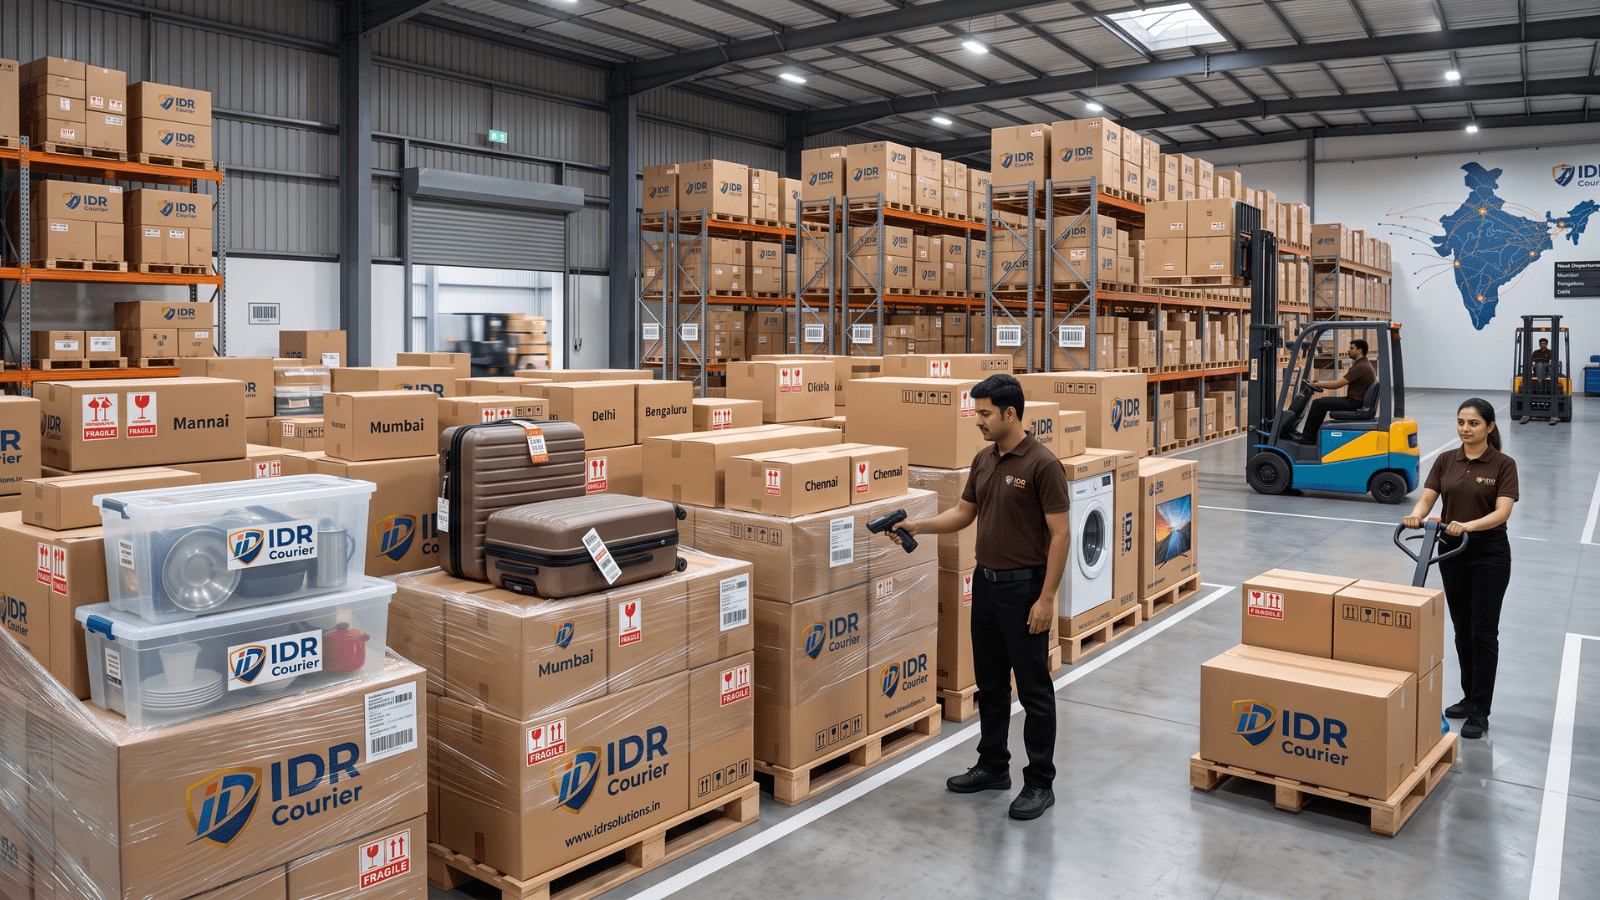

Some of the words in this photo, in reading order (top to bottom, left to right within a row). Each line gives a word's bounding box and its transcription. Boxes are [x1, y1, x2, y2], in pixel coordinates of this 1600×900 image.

[176, 98, 195, 109] IDR
[176, 132, 195, 144] IDR
[1015, 152, 1034, 162] IDR
[1075, 146, 1093, 156] IDR
[819, 171, 833, 180] IDR
[864, 167, 878, 176] IDR
[1579, 165, 1600, 178] ID
[694, 182, 707, 190] IDR
[729, 183, 742, 192] IDR
[84, 195, 107, 207] IDR
[176, 202, 196, 213] IDR
[177, 308, 195, 316] IDR
[592, 409, 616, 421] Delhi
[646, 405, 687, 418] Bengaluru
[1124, 399, 1139, 417] IDR
[48, 414, 61, 432] IDR
[173, 414, 229, 430] Mannai
[370, 418, 424, 433] Mumbai
[1038, 419, 1052, 435] IDR
[86, 429, 115, 437] FRAGILE
[873, 466, 902, 480] Chennai
[805, 476, 838, 491] Chennai
[269, 525, 313, 548] IDR
[269, 546, 314, 560] Courier
[7, 596, 27, 624] IDR
[8, 620, 28, 637] Courier
[830, 612, 859, 639] IDR
[271, 636, 318, 664] IDR
[829, 634, 860, 652] Courier
[272, 658, 320, 677] Courier
[538, 650, 593, 677] Mumbai
[903, 653, 927, 679] IDR
[902, 674, 928, 691] Courier
[723, 688, 749, 704] FRAGILE
[1282, 710, 1348, 749] IDR
[530, 746, 564, 764] FRAGILE
[607, 726, 668, 776] IDR
[1282, 740, 1348, 766] Courier
[271, 742, 361, 802] IDR
[607, 761, 669, 796] Courier
[271, 784, 363, 826] Courier
[565, 801, 660, 848] www.idrsolutions.in
[364, 862, 407, 886] FRAGILE
